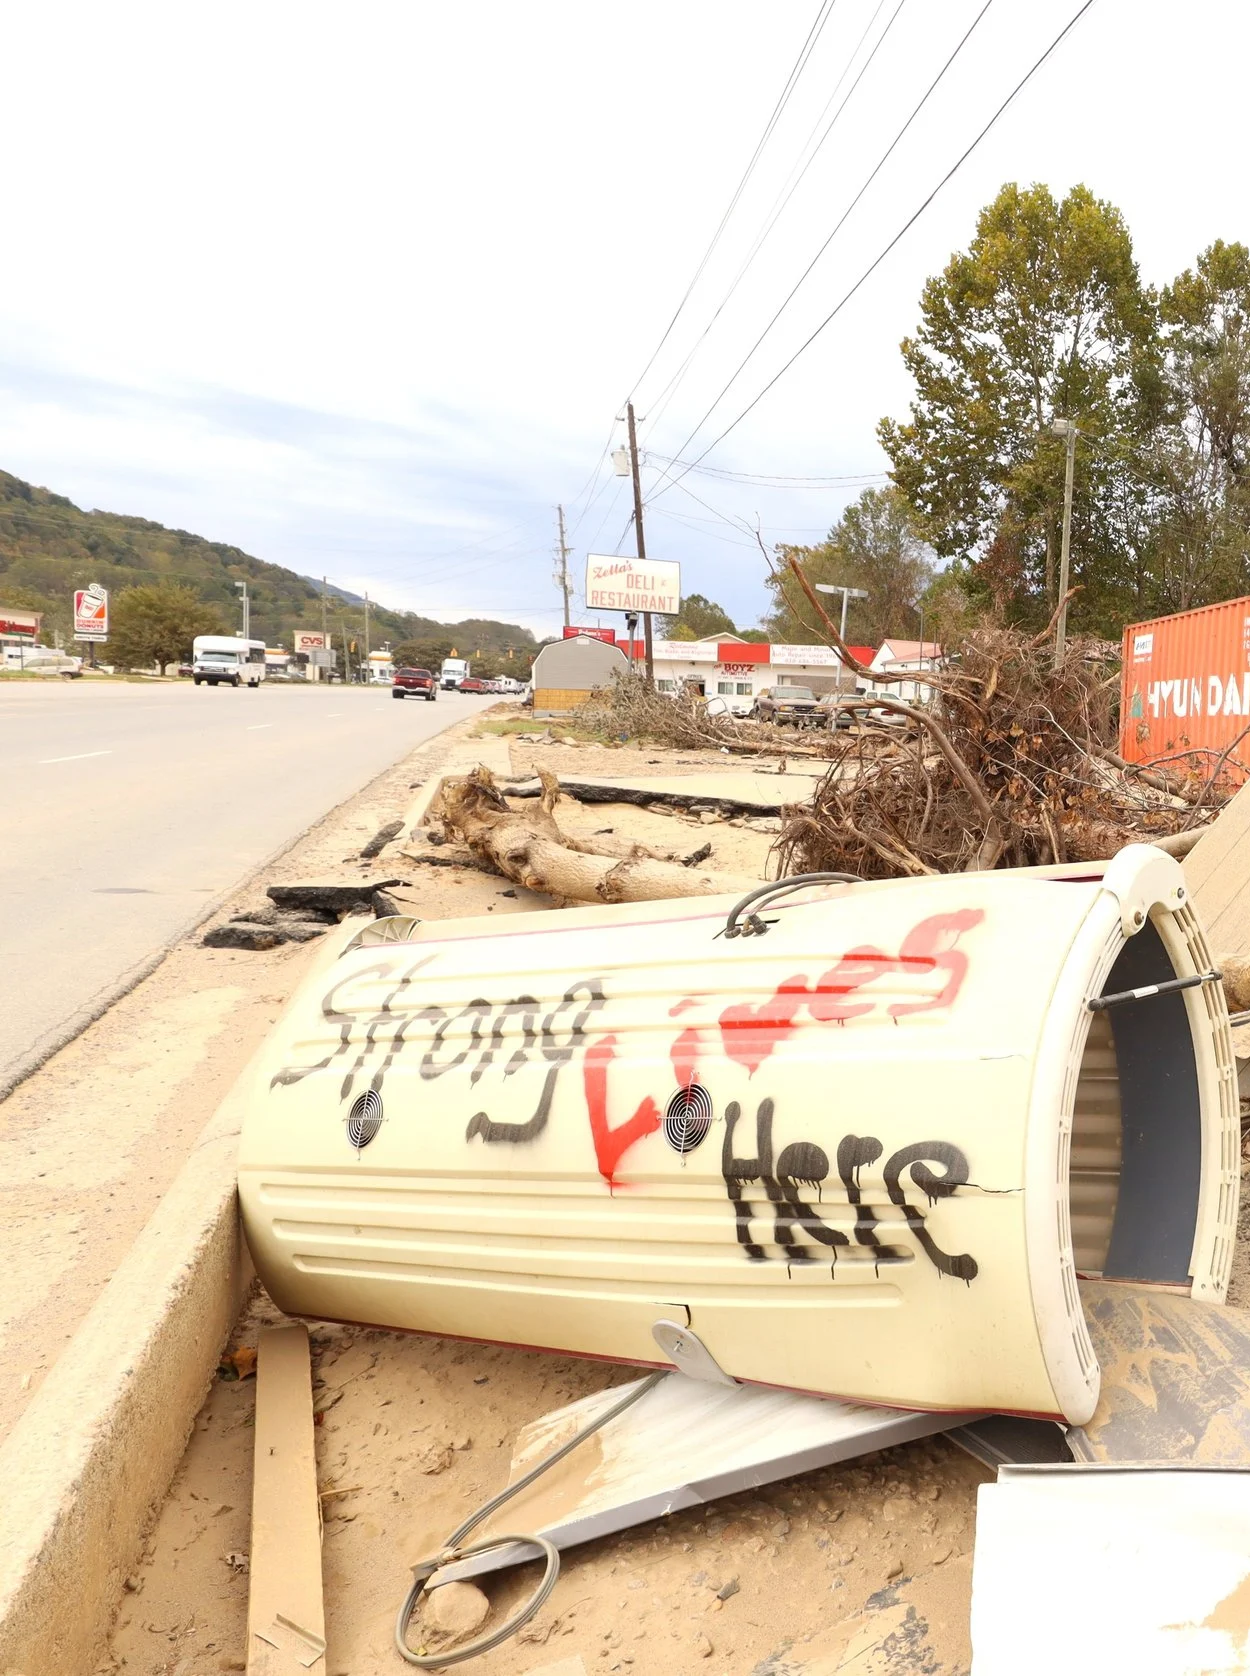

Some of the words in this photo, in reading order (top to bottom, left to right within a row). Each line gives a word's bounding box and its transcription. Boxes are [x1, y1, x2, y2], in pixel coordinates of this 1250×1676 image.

[626, 573, 655, 591] DELI
[591, 590, 675, 612] RESTAURANT
[301, 636, 323, 645] CVS
[724, 663, 755, 673] BOYZ
[269, 953, 607, 1145] Strong
[583, 908, 985, 1192] Lives
[720, 1097, 979, 1282] Here
